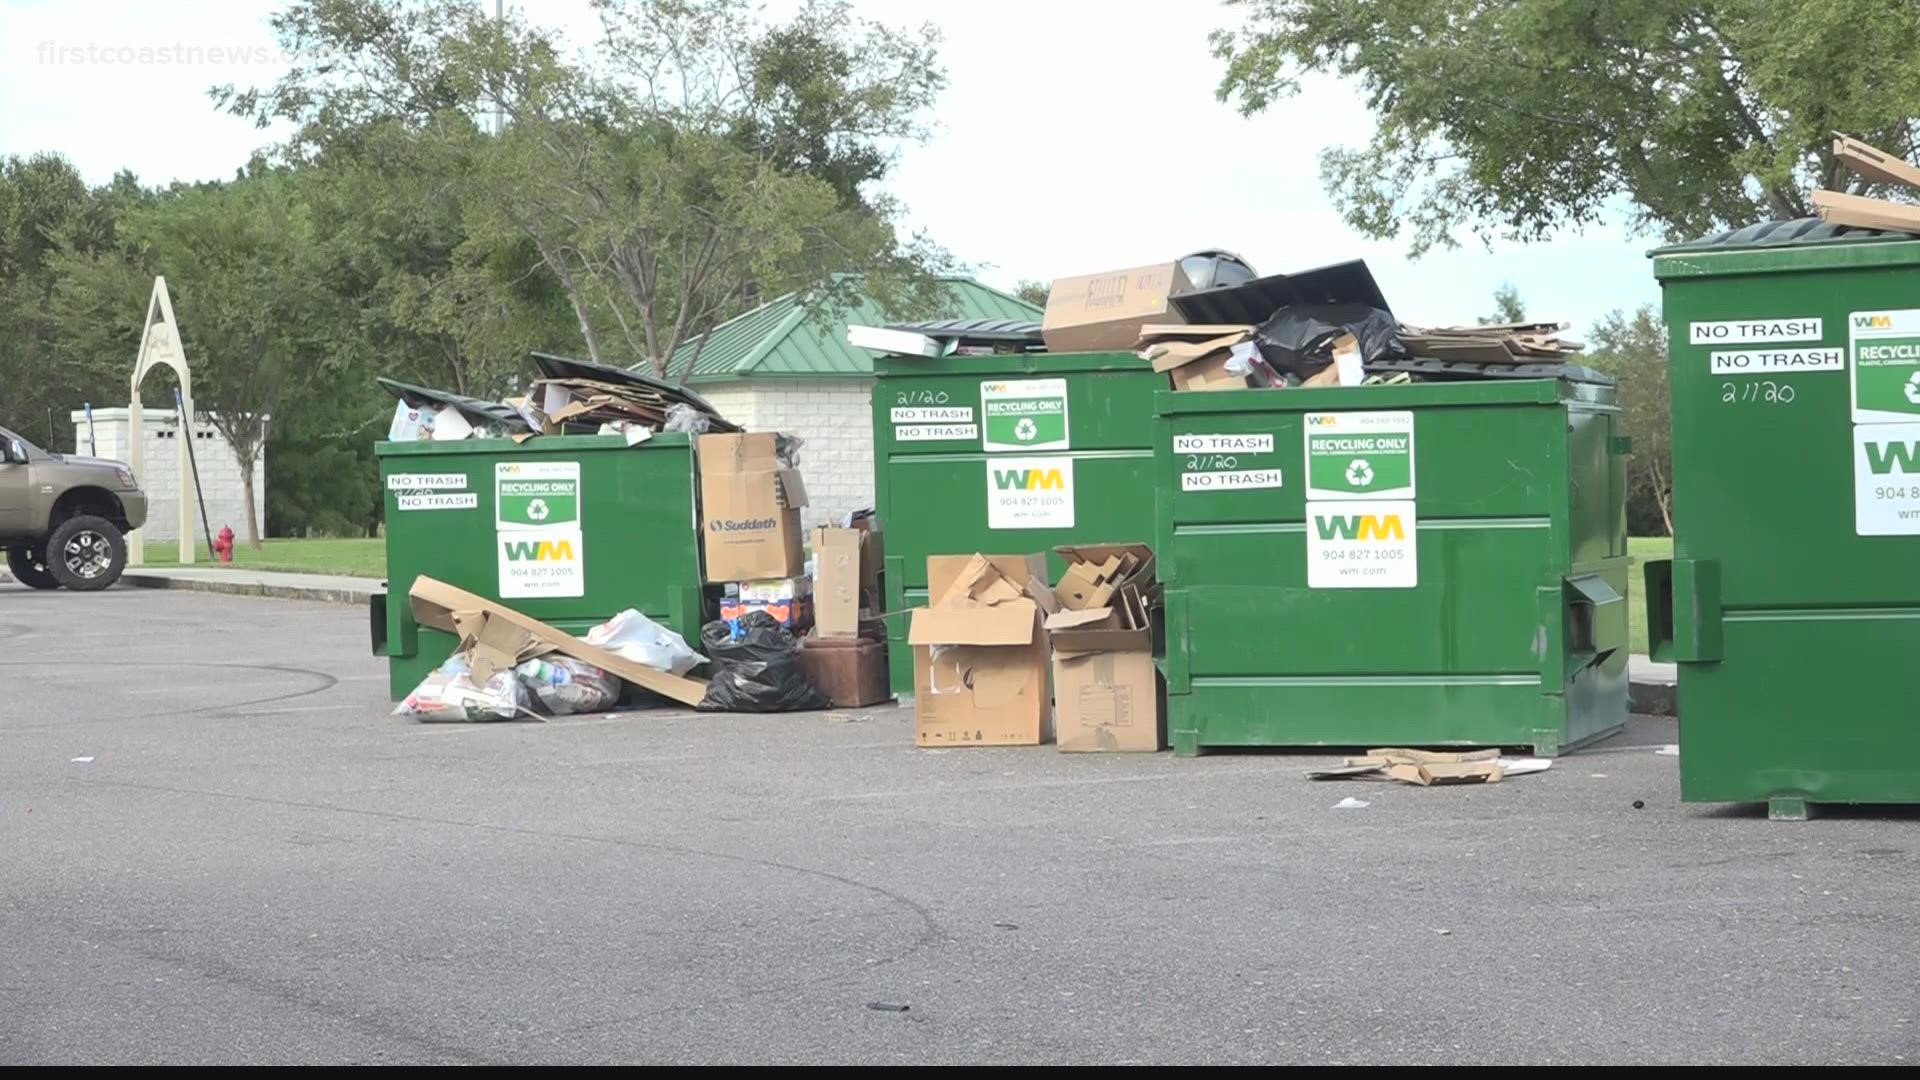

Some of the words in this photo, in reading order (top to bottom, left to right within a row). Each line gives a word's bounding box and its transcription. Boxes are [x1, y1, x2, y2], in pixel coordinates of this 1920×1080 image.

[1854, 315, 1892, 328] WM
[1696, 325, 1729, 339] NO
[1737, 322, 1817, 337] TRASH
[1717, 354, 1750, 368] NO
[1758, 351, 1839, 366] TRASH
[987, 402, 1037, 412] RECYCLING
[1039, 400, 1062, 410] ONLY
[894, 410, 916, 419] NO
[921, 409, 970, 418] TRASH
[1307, 416, 1337, 426] WM
[899, 428, 920, 438] NO
[926, 427, 975, 436] TRASH
[1178, 438, 1203, 450] NO
[1212, 437, 1270, 449] TRASH
[1312, 439, 1374, 451] RECYCLING
[1376, 438, 1407, 450] ONLY
[391, 477, 412, 486] NO
[417, 476, 464, 486] TRASH
[993, 469, 1065, 491] WM
[1186, 474, 1212, 486] NO
[1218, 472, 1278, 485] TRASH
[501, 482, 550, 492] RECYCLING
[551, 482, 575, 492] ONLY
[1875, 486, 1905, 500] 904
[401, 498, 422, 507] NO
[427, 496, 474, 506] TRASH
[1000, 497, 1018, 506] 904
[1020, 496, 1038, 506] 827
[1041, 496, 1065, 506] 1005
[724, 516, 777, 532] Suddath
[1314, 515, 1405, 540] WM
[504, 540, 575, 562] WM
[1323, 550, 1346, 560] 904
[1349, 550, 1370, 560] 827
[1374, 550, 1403, 560] 1005
[510, 568, 528, 577] 904
[531, 568, 547, 577] 827
[550, 567, 574, 576] 1005
